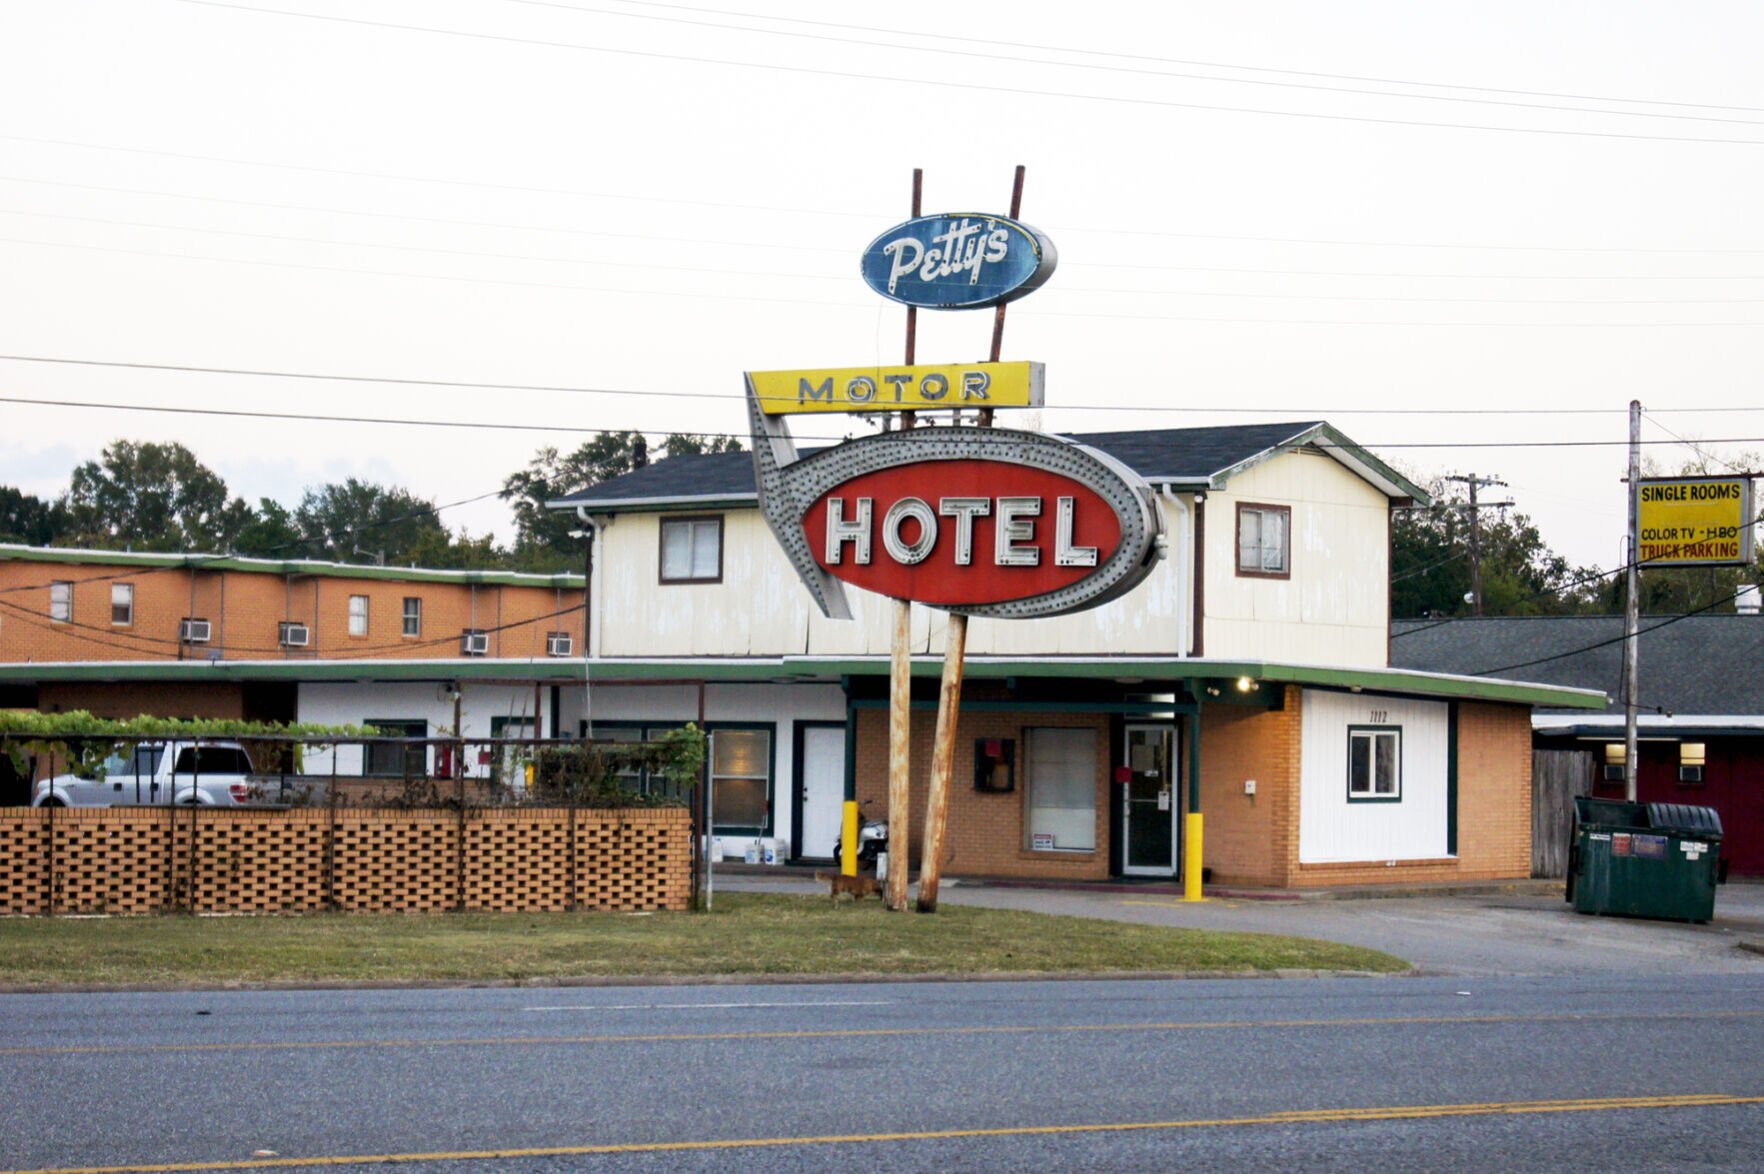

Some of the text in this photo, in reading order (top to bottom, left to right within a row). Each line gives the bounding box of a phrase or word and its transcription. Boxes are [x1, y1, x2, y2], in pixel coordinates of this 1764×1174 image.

[883, 219, 1009, 294] Petty's
[798, 371, 991, 406] MOTOR
[1642, 484, 1740, 501] SINGLE ROOMS
[825, 496, 1098, 566] HOTEL
[1641, 528, 1678, 541] COLOR
[1681, 528, 1695, 539] TV
[1706, 526, 1738, 539] HBO
[1640, 542, 1739, 559] TRUCK PARKING
[1370, 711, 1387, 722] 1112
